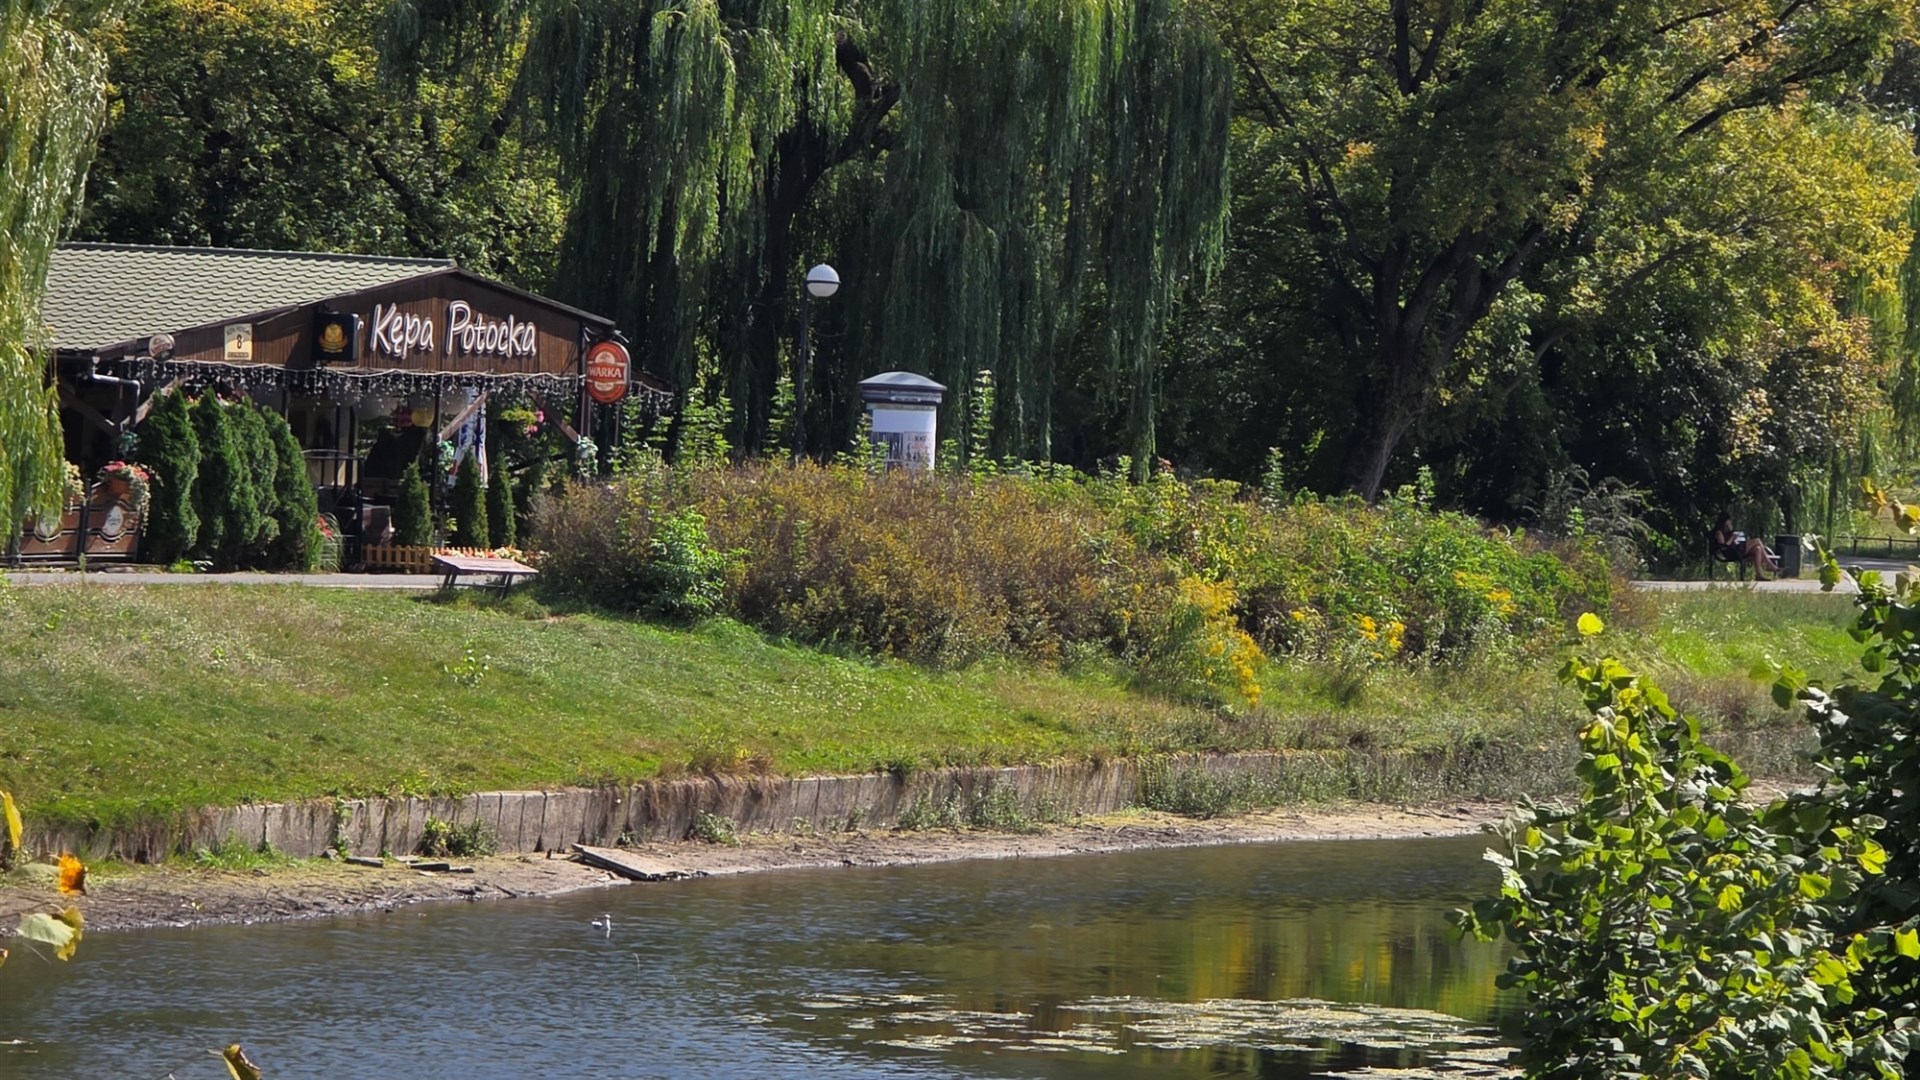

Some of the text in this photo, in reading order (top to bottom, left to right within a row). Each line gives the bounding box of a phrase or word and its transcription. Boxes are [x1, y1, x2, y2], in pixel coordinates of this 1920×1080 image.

[371, 300, 537, 359] Kępa Potocka
[236, 333, 243, 350] 8
[588, 366, 622, 378] WARKA
